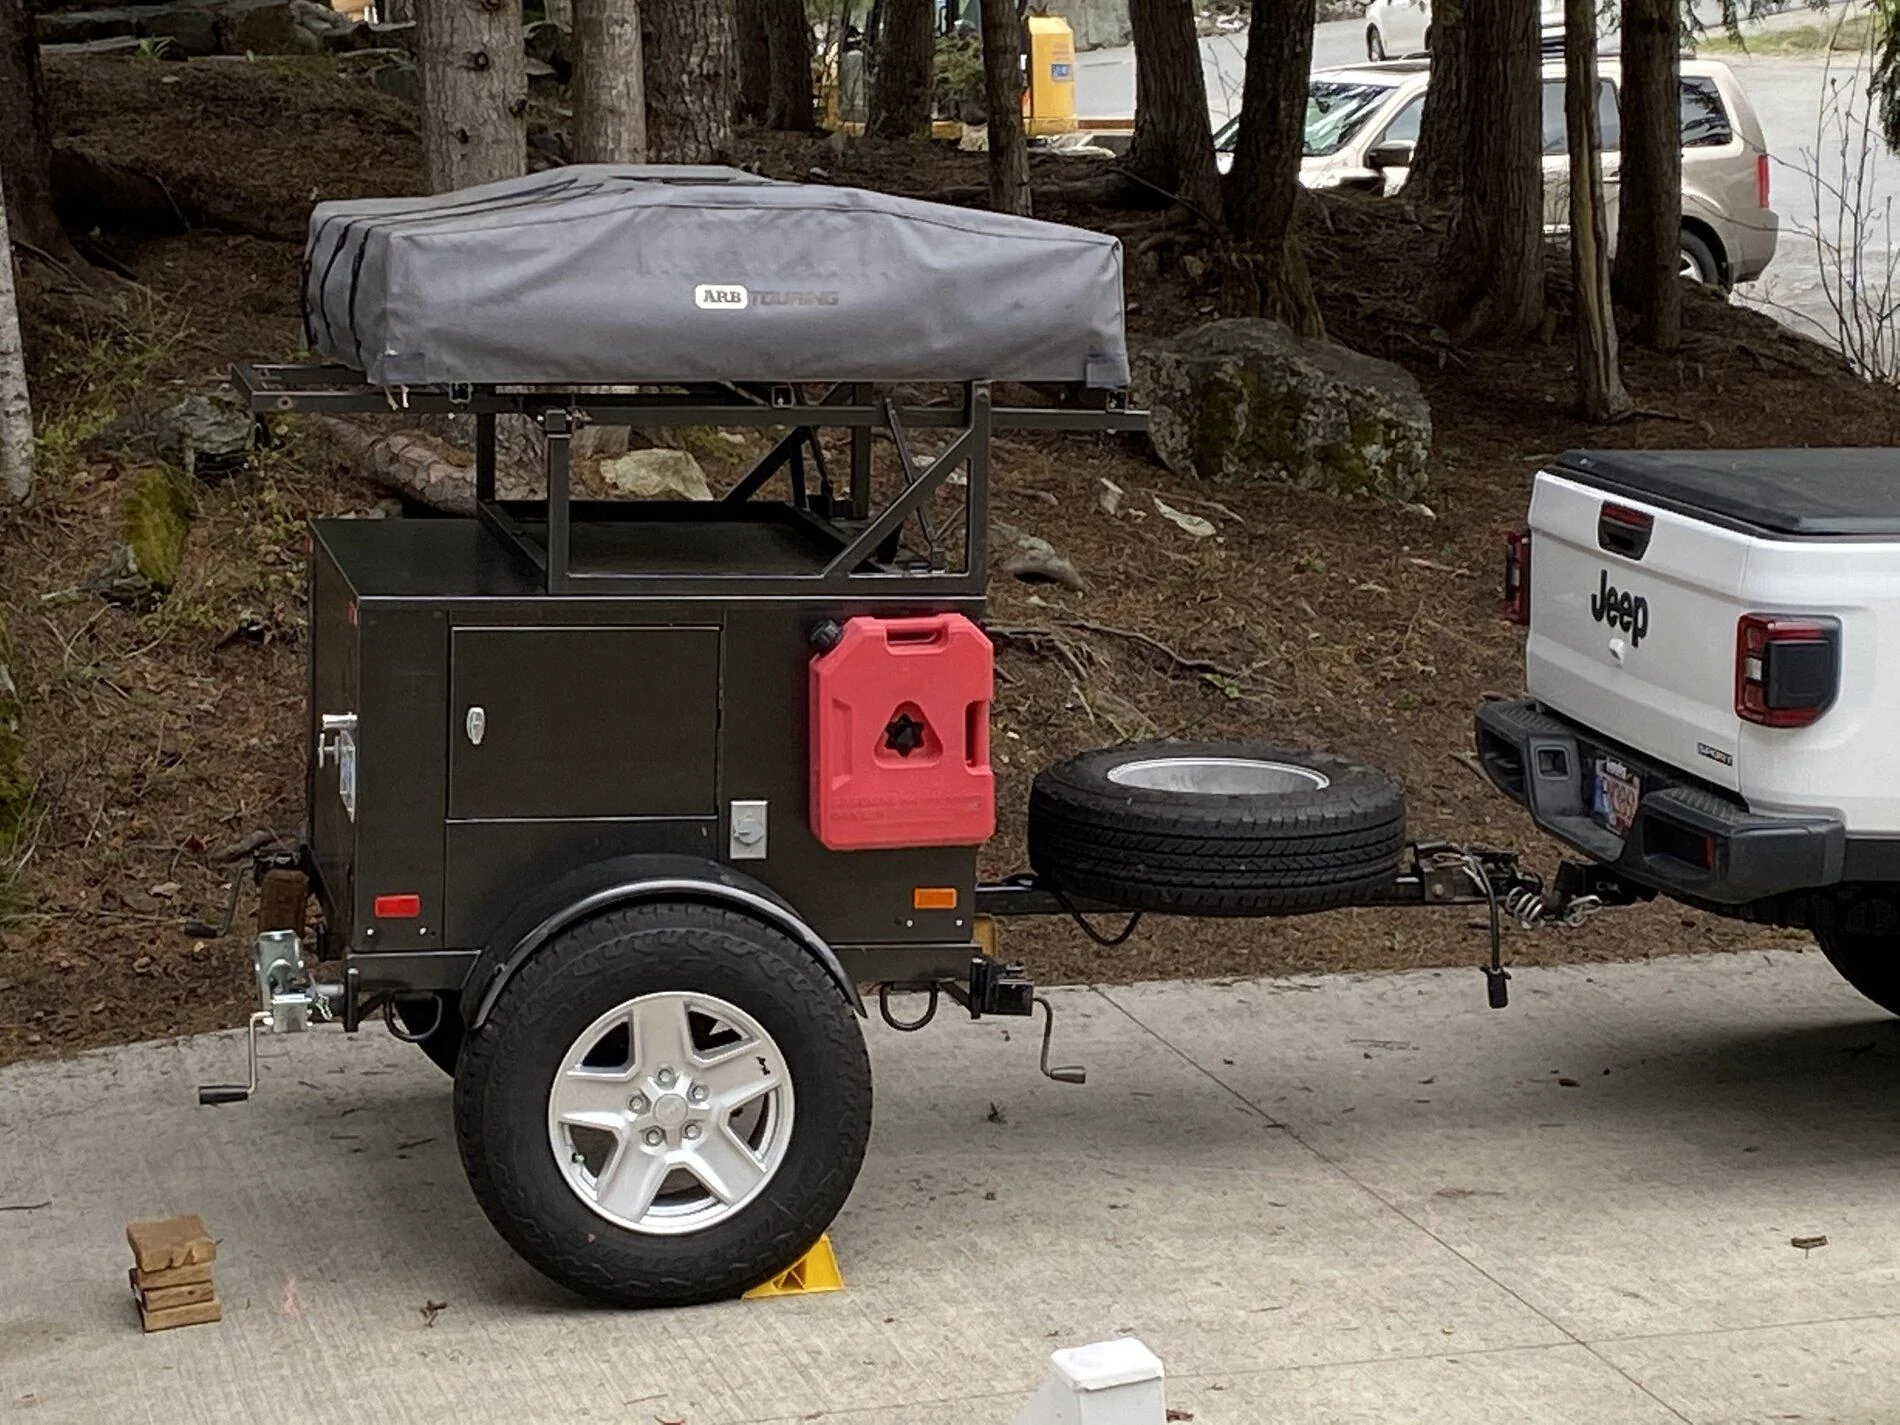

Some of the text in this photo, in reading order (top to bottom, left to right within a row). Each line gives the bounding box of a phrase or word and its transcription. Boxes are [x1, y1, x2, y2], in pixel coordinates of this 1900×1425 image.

[703, 289, 839, 306] ARB TOURING
[1591, 569, 1649, 648] Jeep
